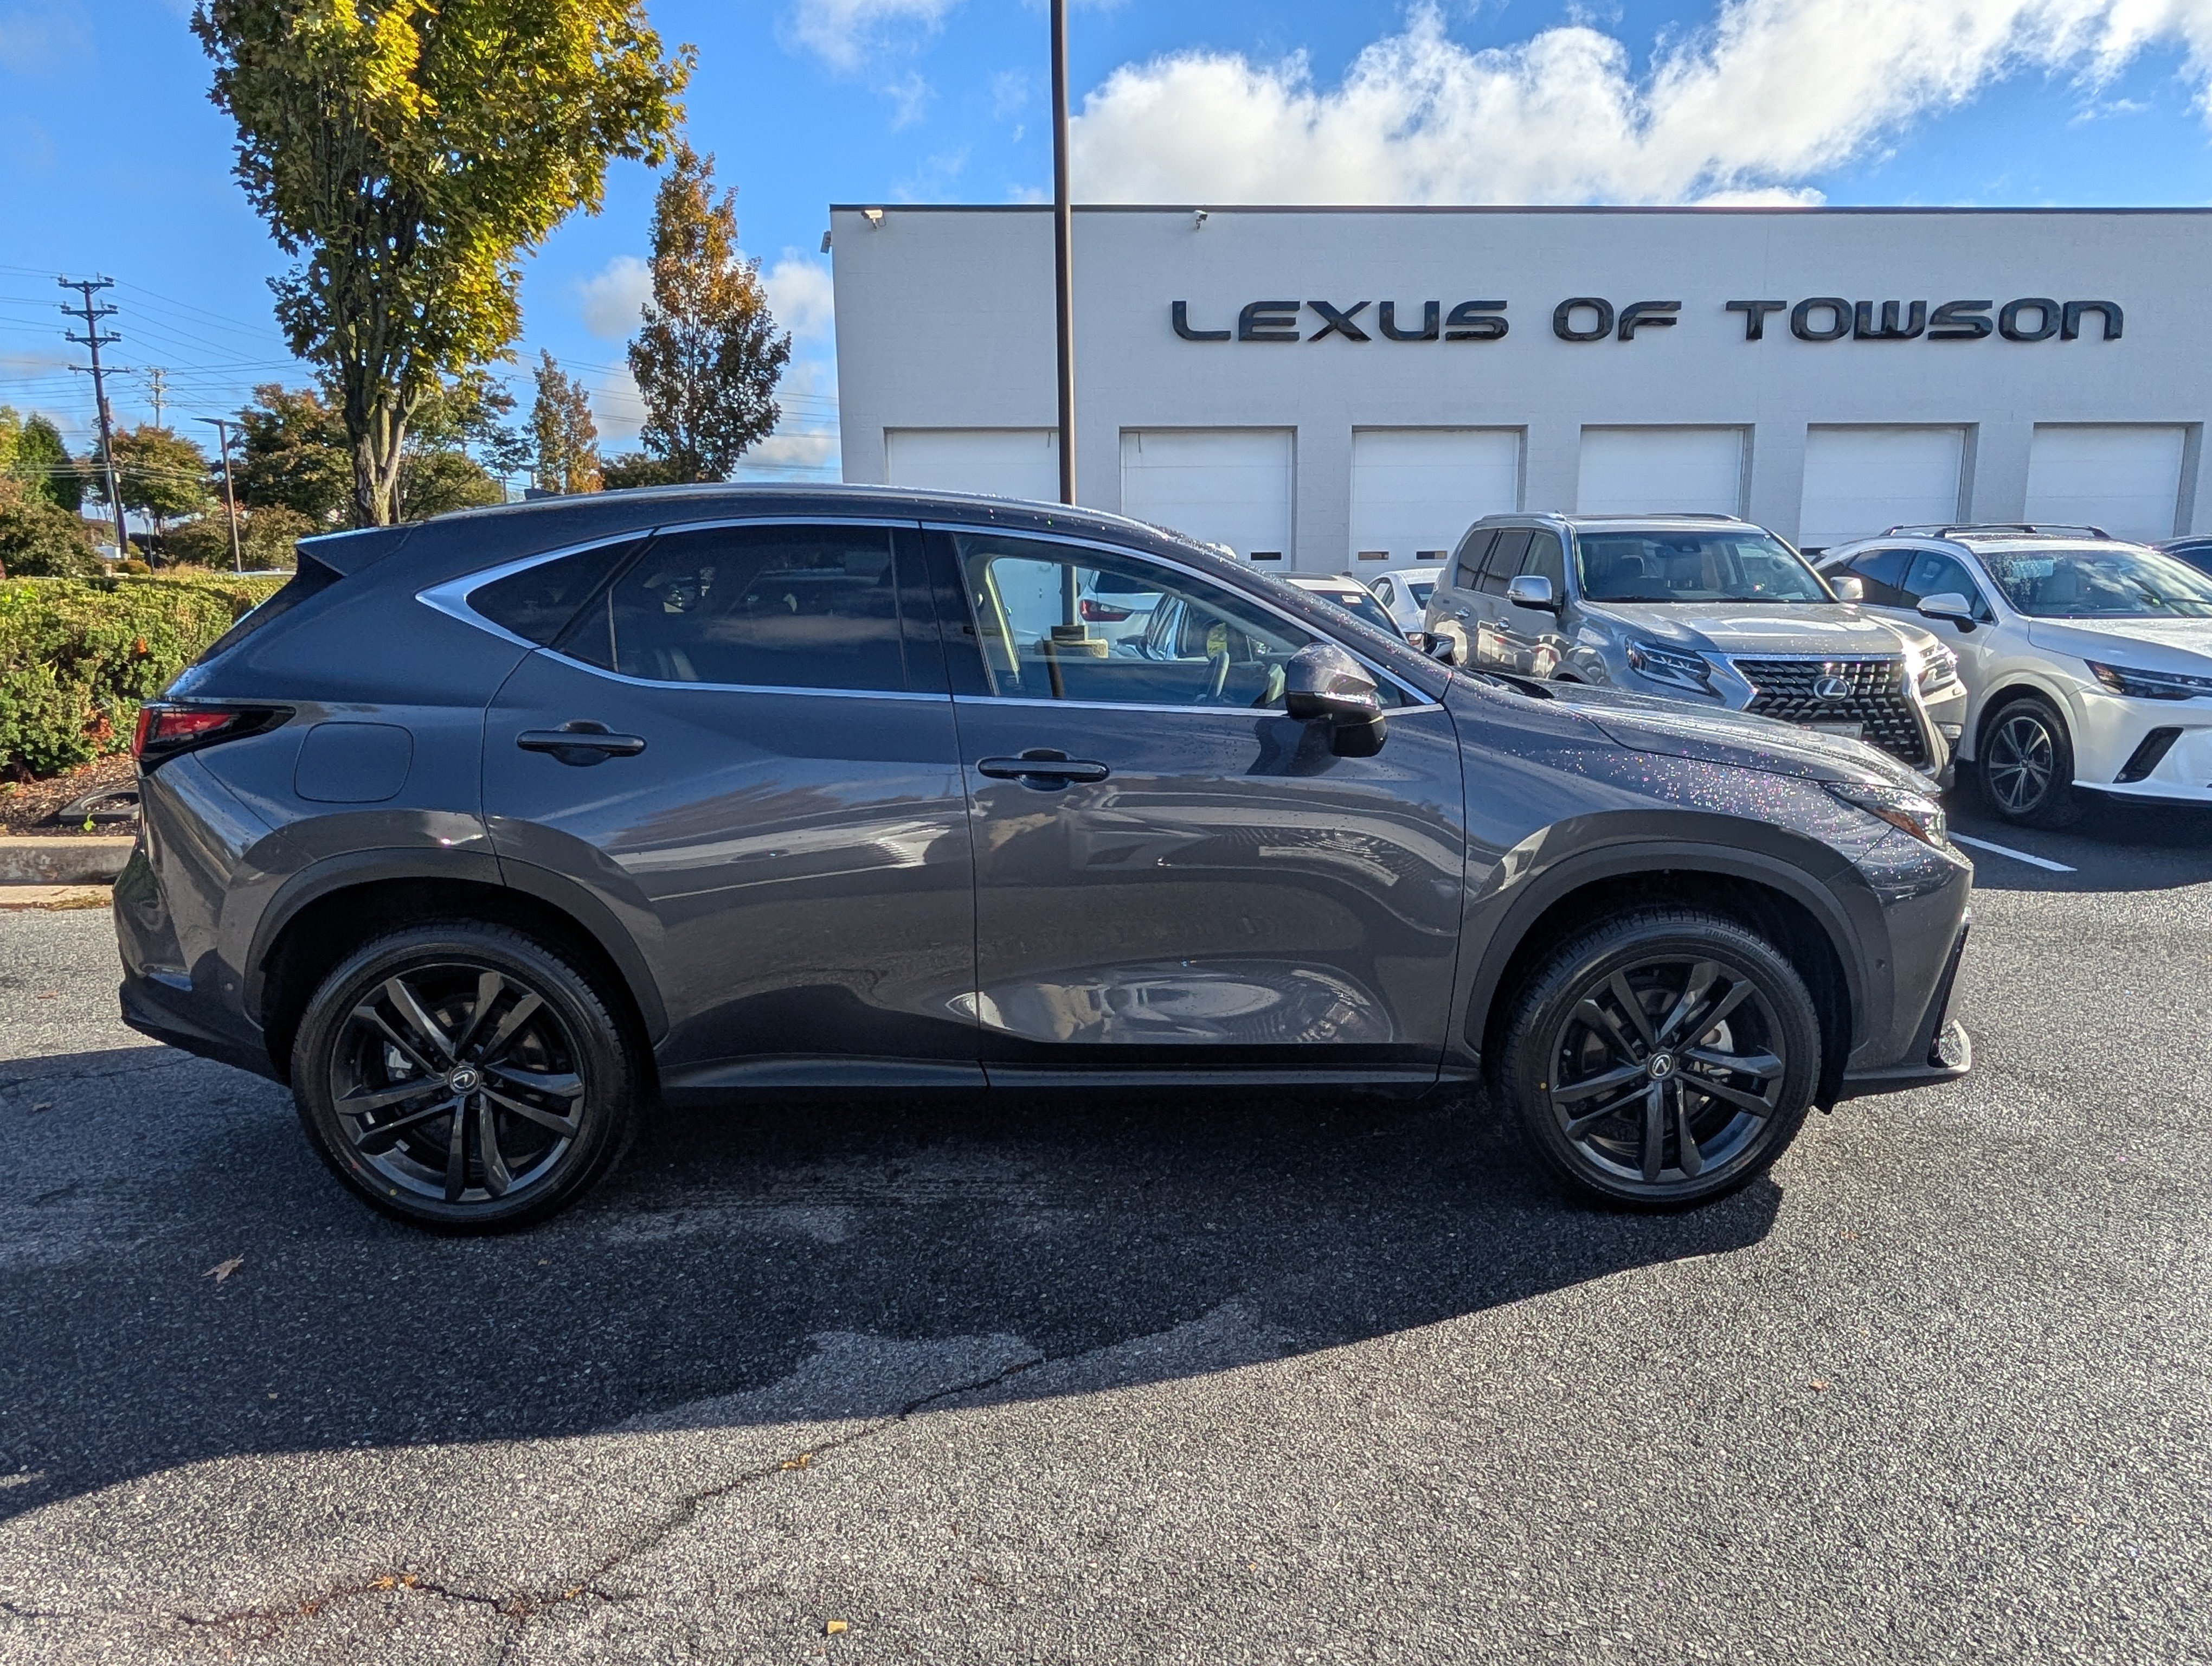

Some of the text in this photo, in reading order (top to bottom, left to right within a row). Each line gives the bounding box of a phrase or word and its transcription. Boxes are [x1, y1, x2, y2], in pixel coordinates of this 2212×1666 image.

[1172, 297, 2124, 342] LEXUS OF TOWSON
